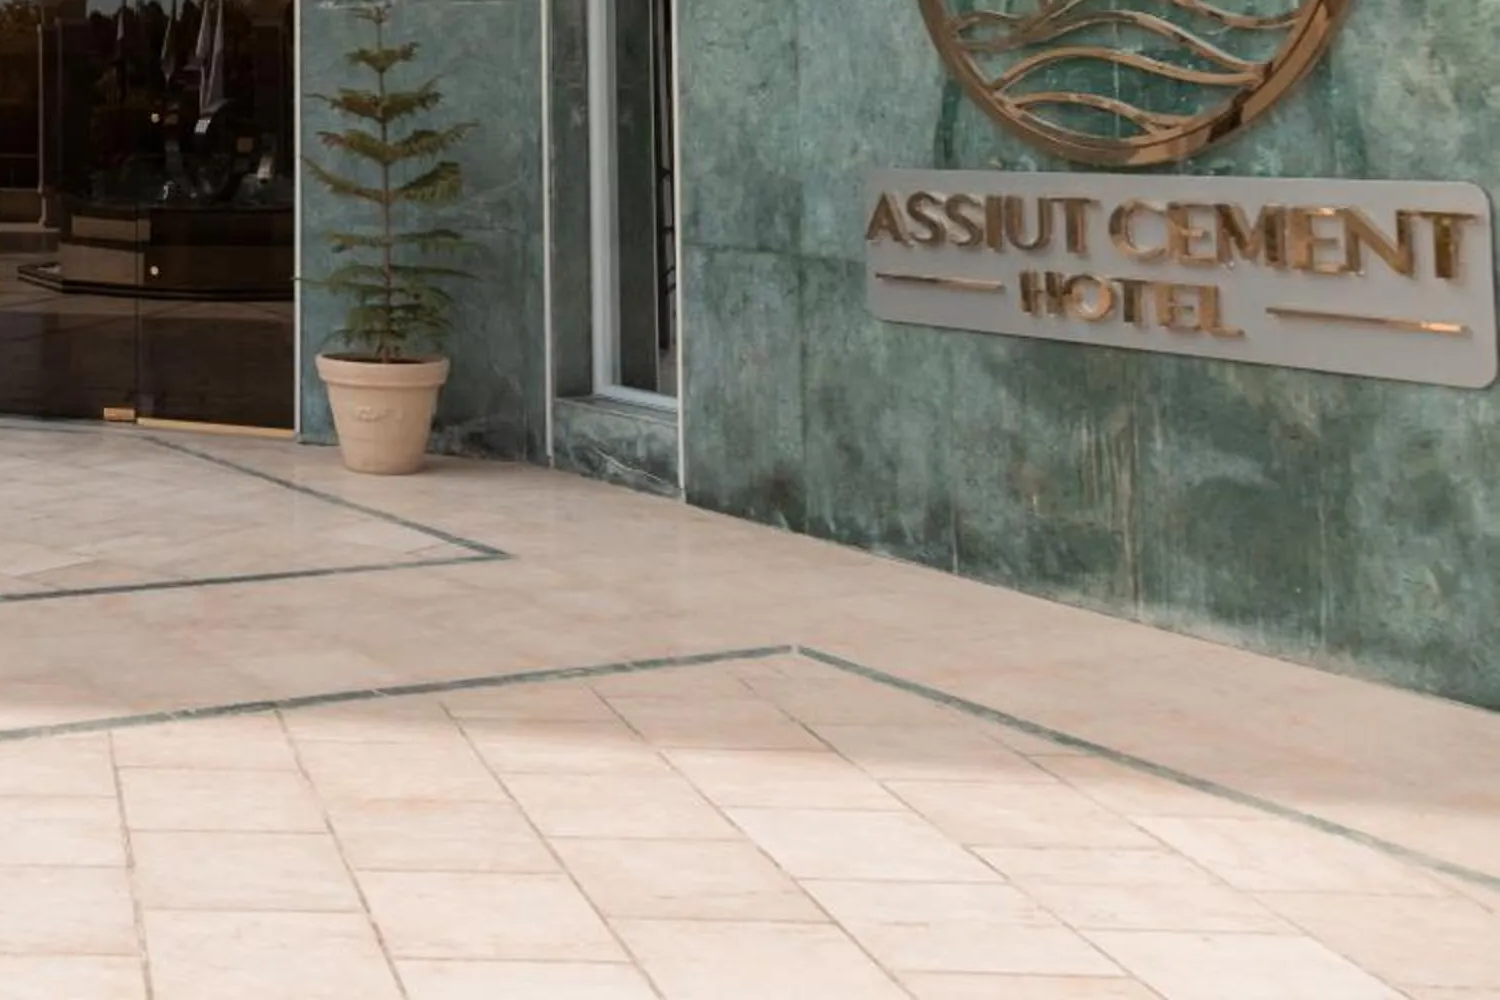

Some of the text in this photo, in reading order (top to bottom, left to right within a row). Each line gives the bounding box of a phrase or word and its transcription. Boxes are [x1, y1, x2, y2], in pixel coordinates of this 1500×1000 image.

[865, 191, 1479, 279] ASSIUT CEMENT
[1018, 269, 1245, 338] HOTEL
